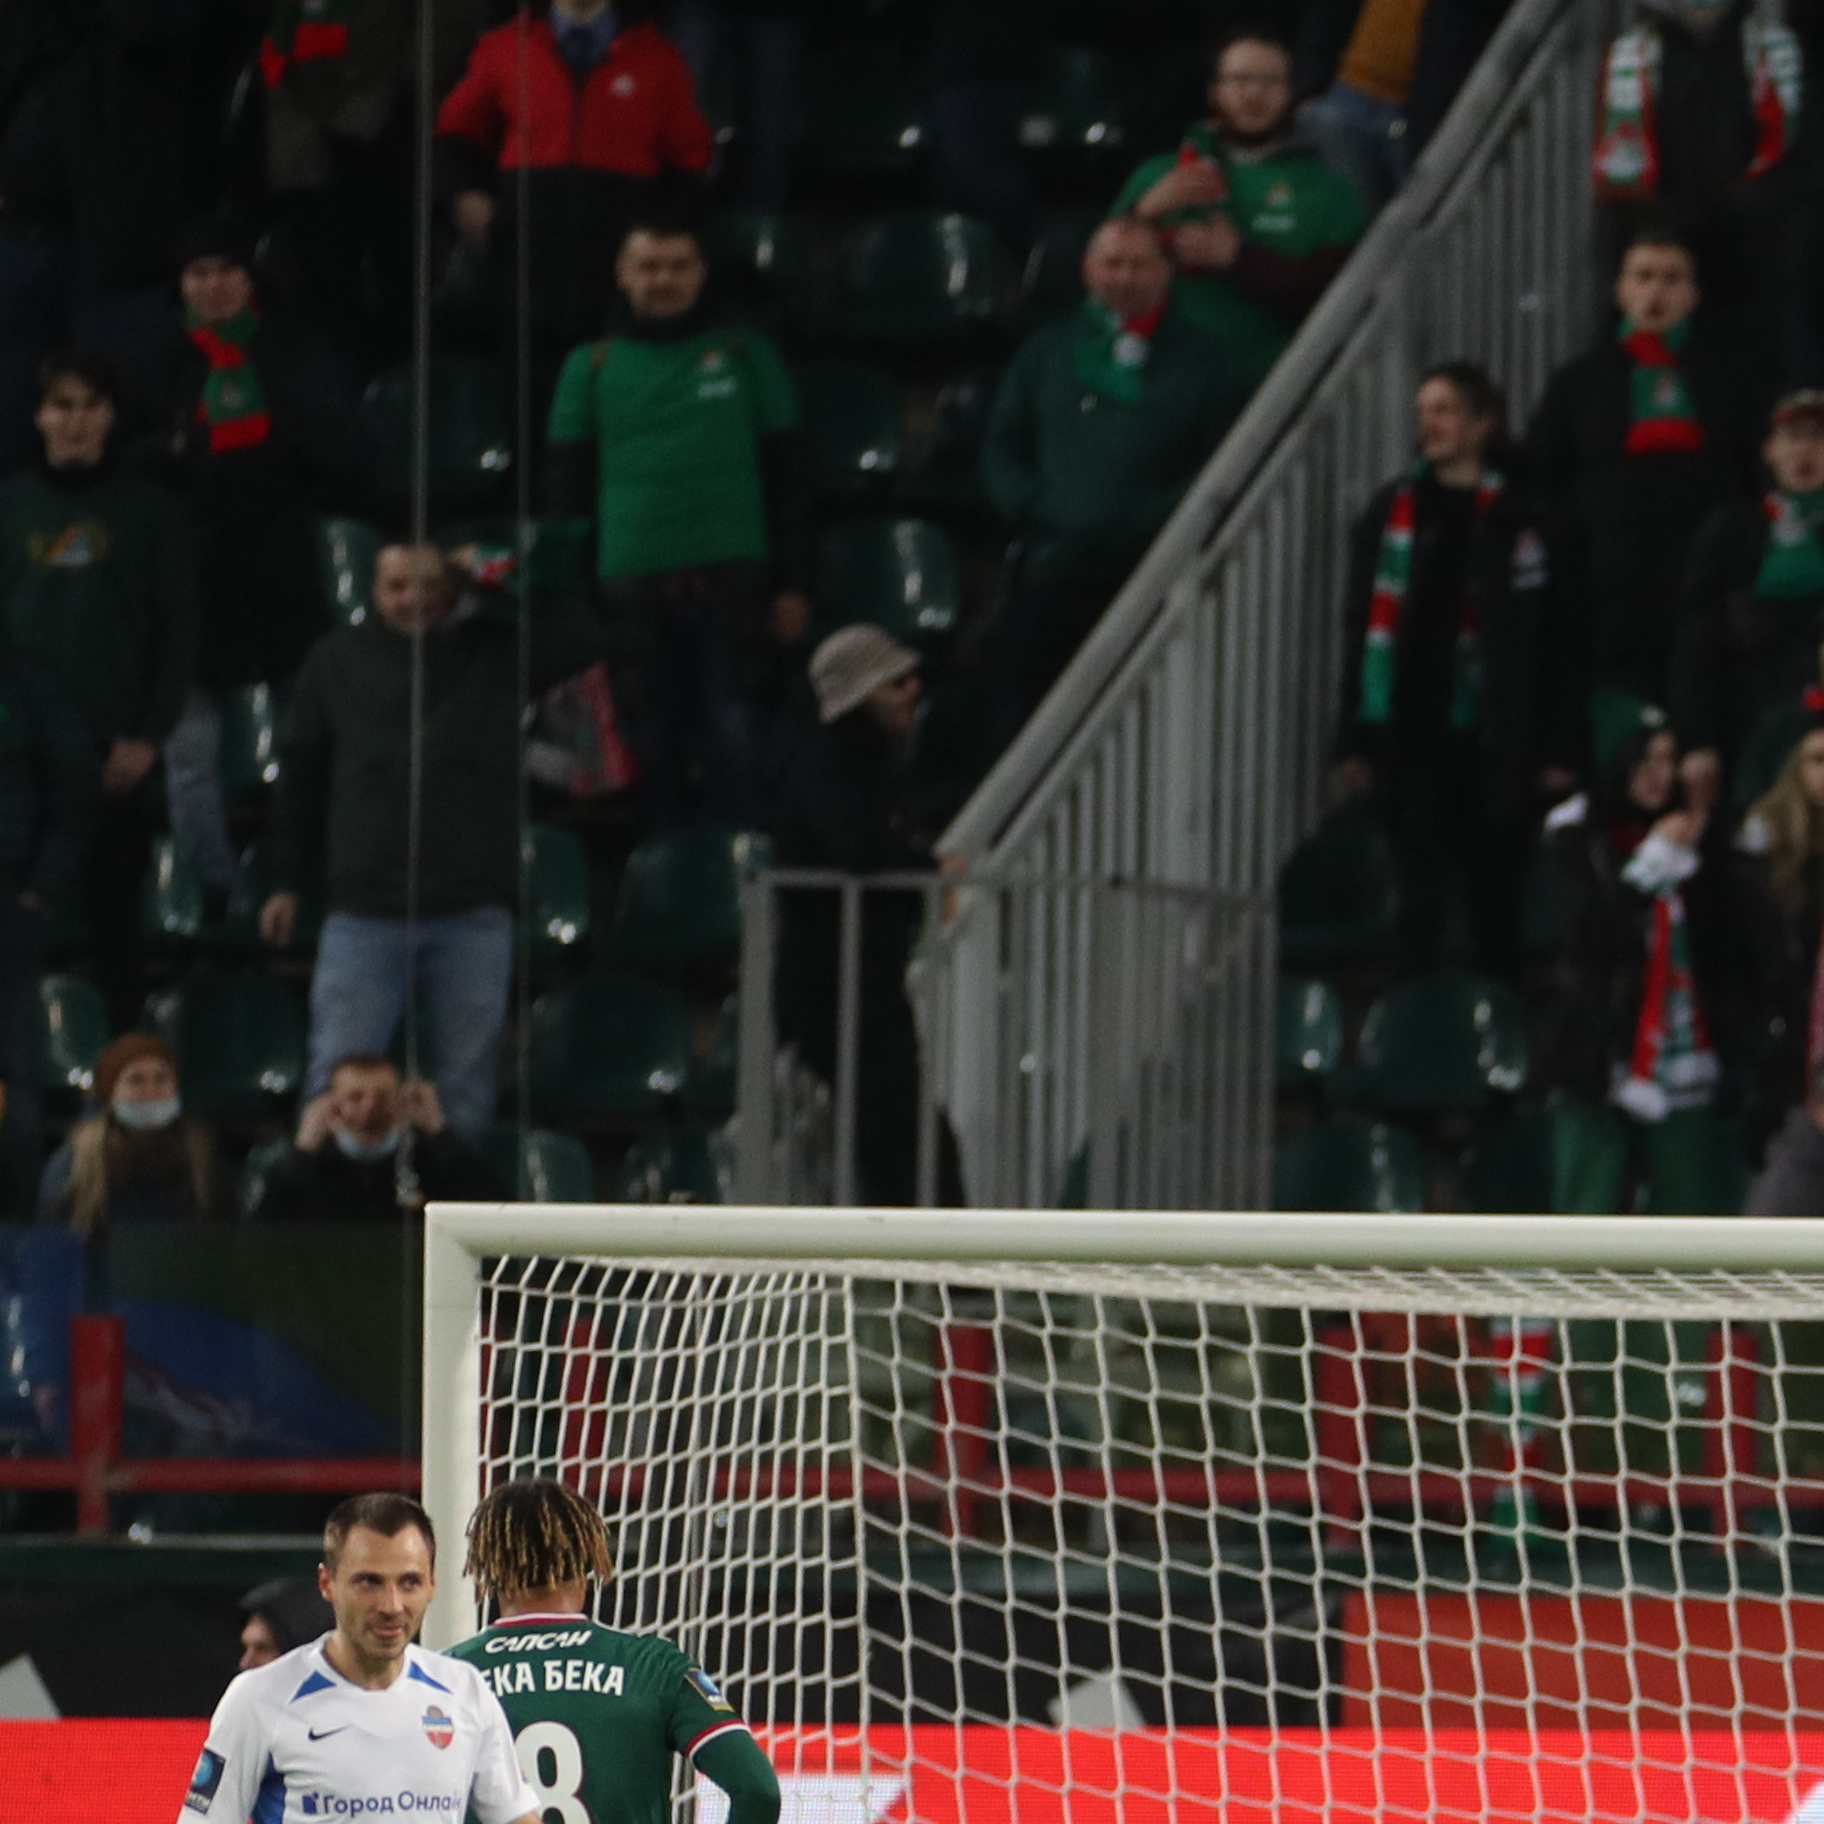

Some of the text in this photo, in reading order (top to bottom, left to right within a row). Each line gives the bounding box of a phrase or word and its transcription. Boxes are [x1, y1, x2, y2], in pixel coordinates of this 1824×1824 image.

[485, 1630, 592, 1653] САПСАН
[543, 1659, 625, 1696] БЕКА
[322, 1792, 394, 1817] Город
